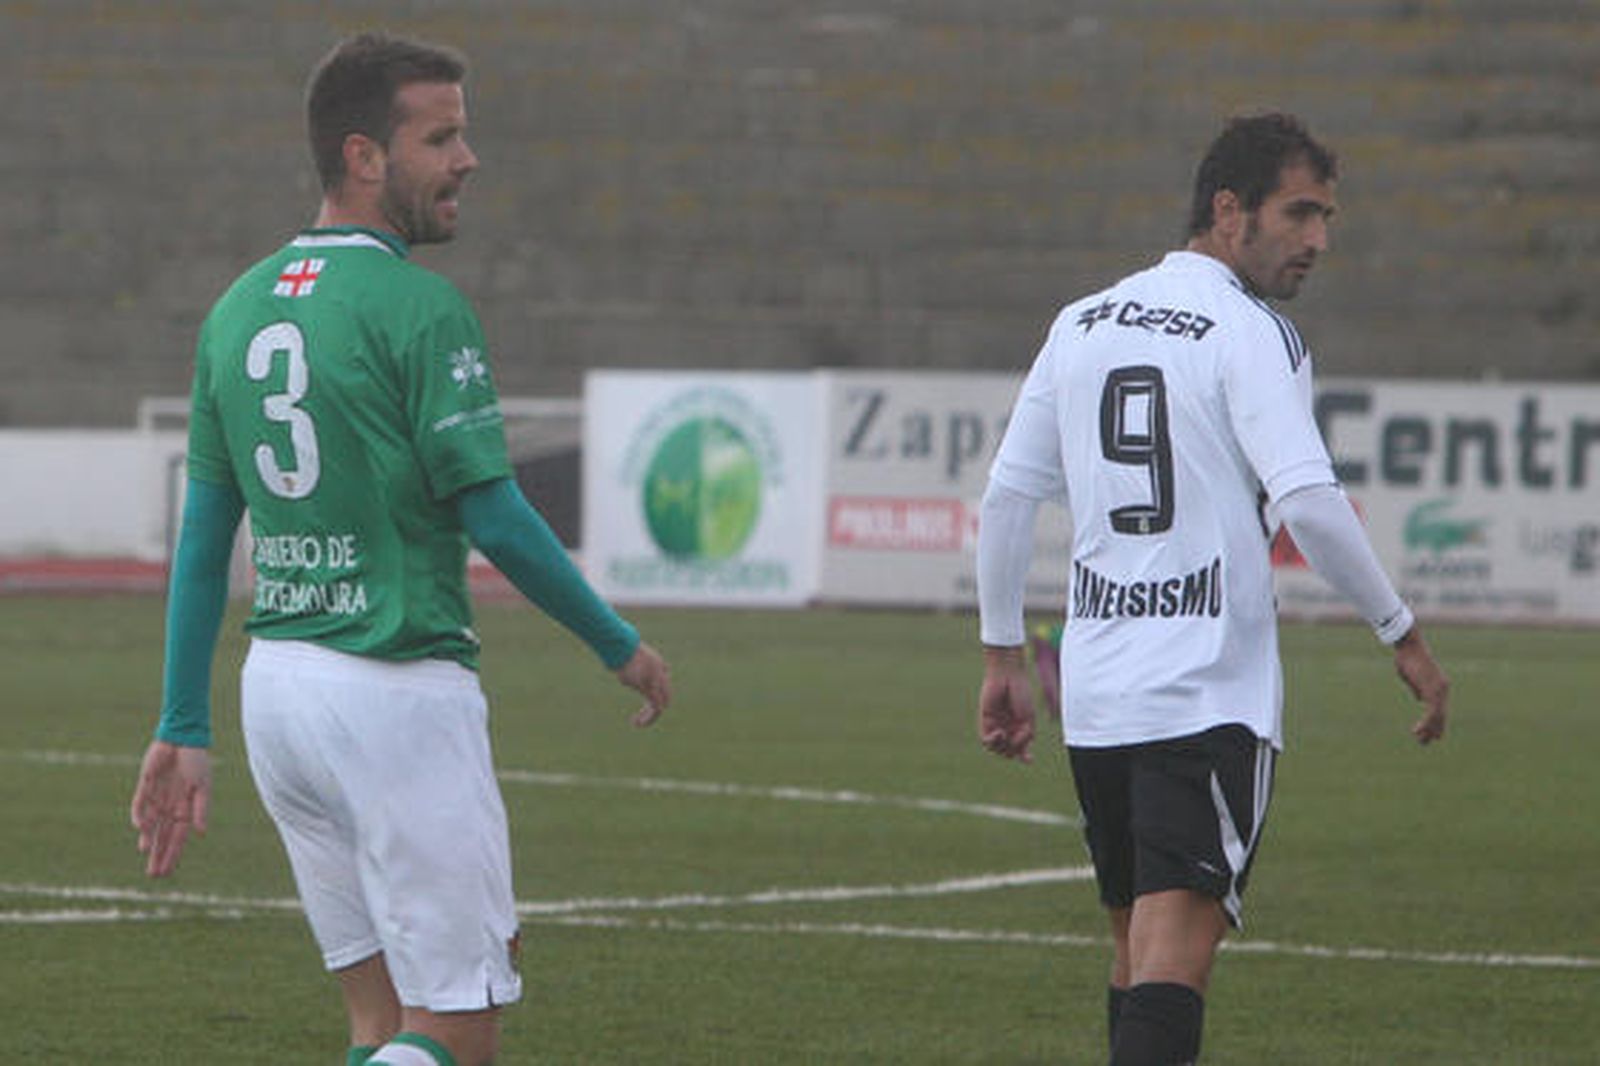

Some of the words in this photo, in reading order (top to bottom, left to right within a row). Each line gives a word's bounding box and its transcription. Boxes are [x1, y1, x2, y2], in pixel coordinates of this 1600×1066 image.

[246, 322, 321, 500] 3
[1100, 364, 1175, 535] 9
[1313, 393, 1600, 488] Centr
[327, 534, 357, 569] DE
